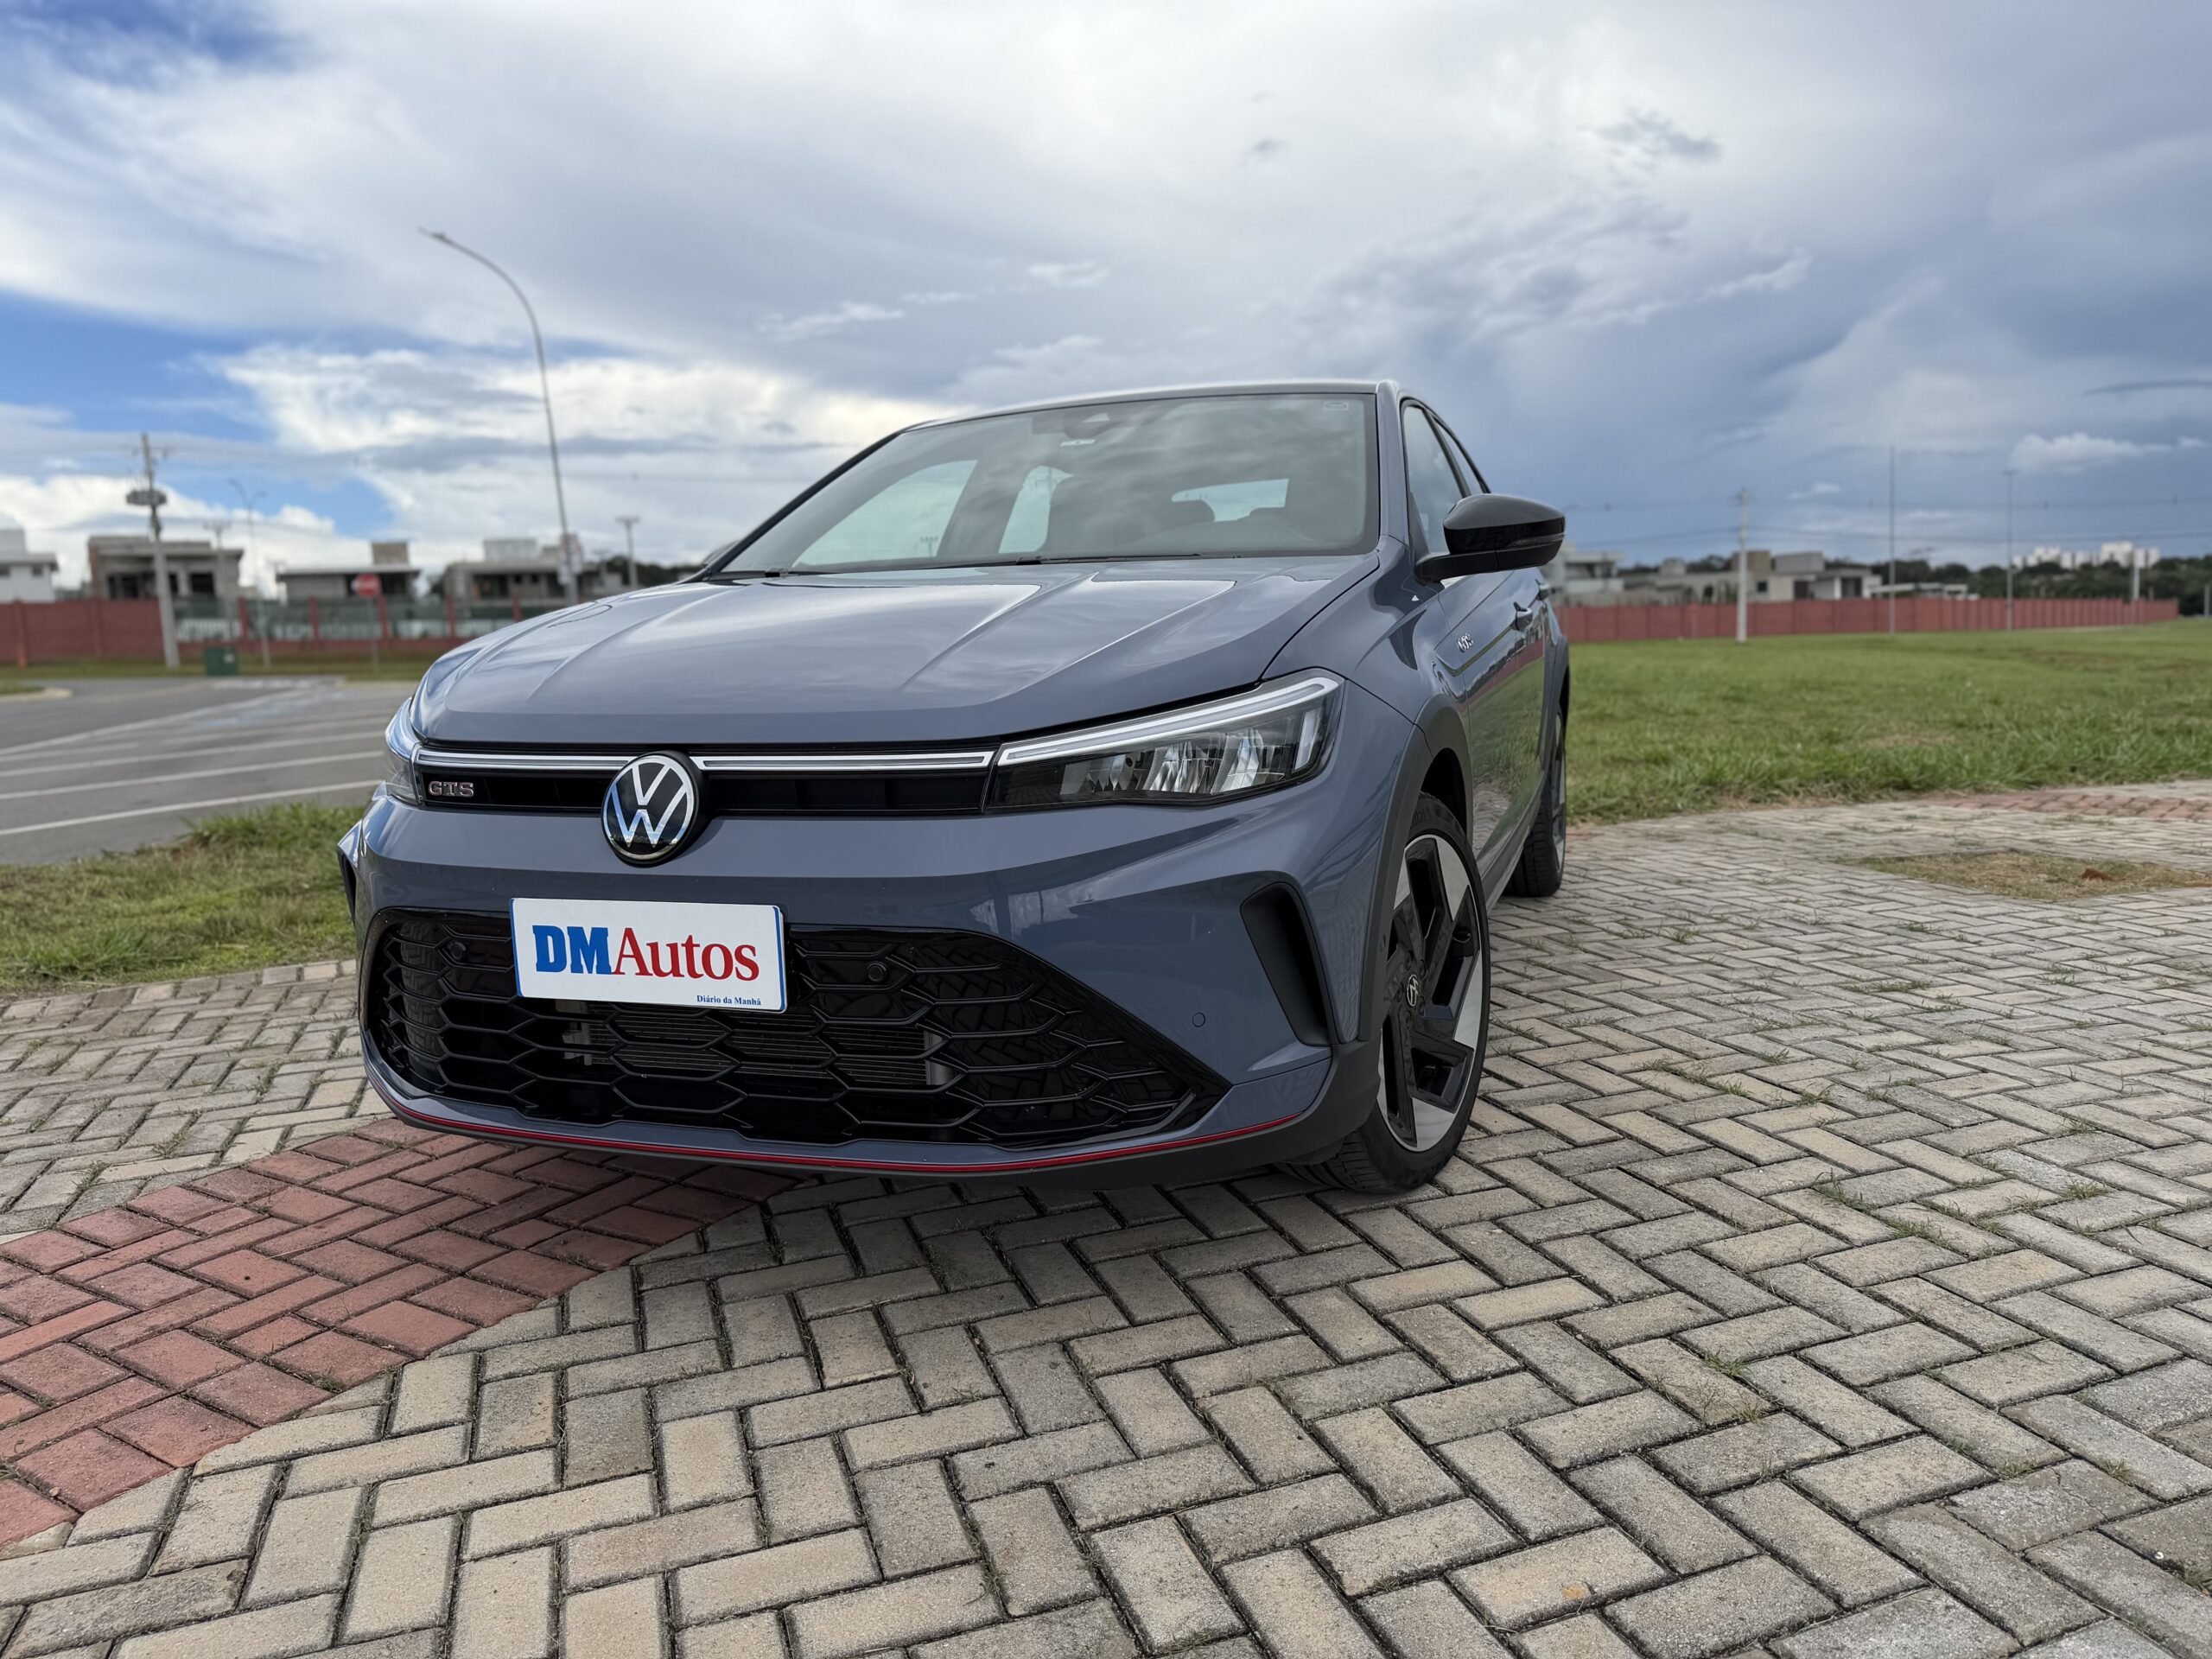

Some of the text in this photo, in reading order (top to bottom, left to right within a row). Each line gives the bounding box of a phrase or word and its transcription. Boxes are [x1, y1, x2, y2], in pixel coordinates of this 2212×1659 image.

[428, 780, 475, 798] GTS
[696, 995, 721, 1003] Diário
[734, 996, 761, 1006] Manhã
